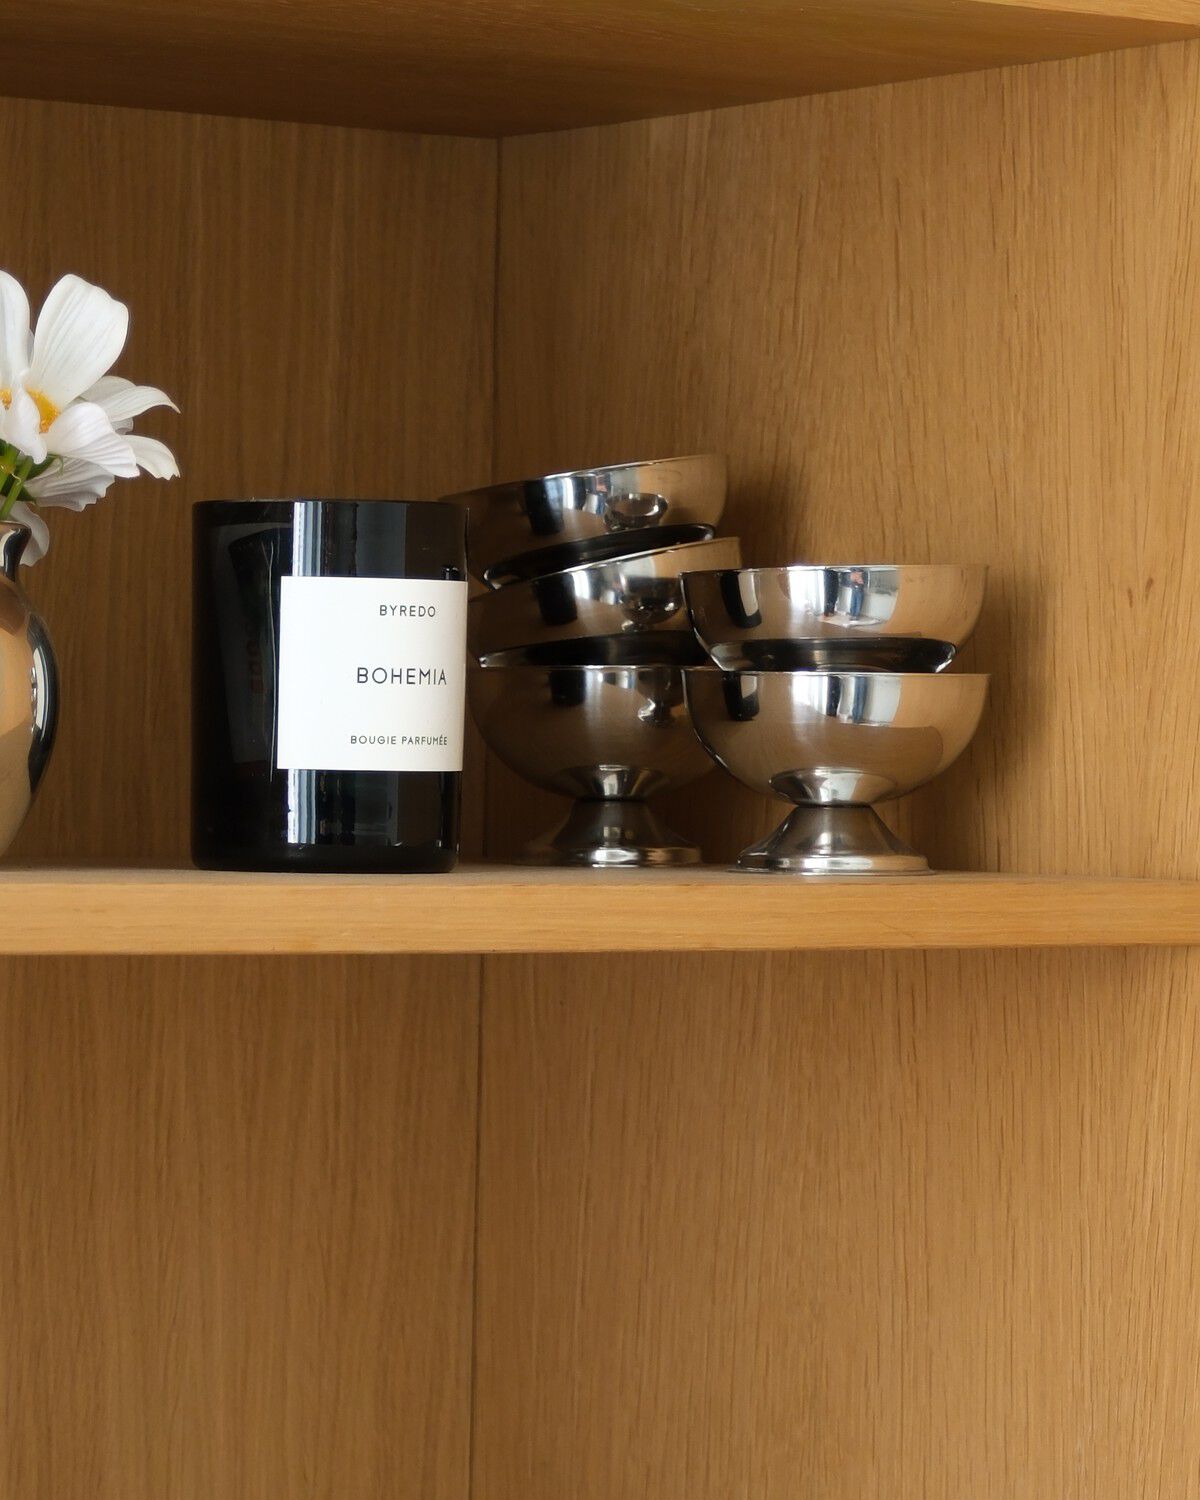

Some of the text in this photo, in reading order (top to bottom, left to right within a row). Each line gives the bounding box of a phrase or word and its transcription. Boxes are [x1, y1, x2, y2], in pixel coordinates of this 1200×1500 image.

[379, 604, 437, 618] BYREDO
[356, 667, 447, 685] BOHEMIA
[350, 734, 448, 746] BOUGIE PARFUMÉE
